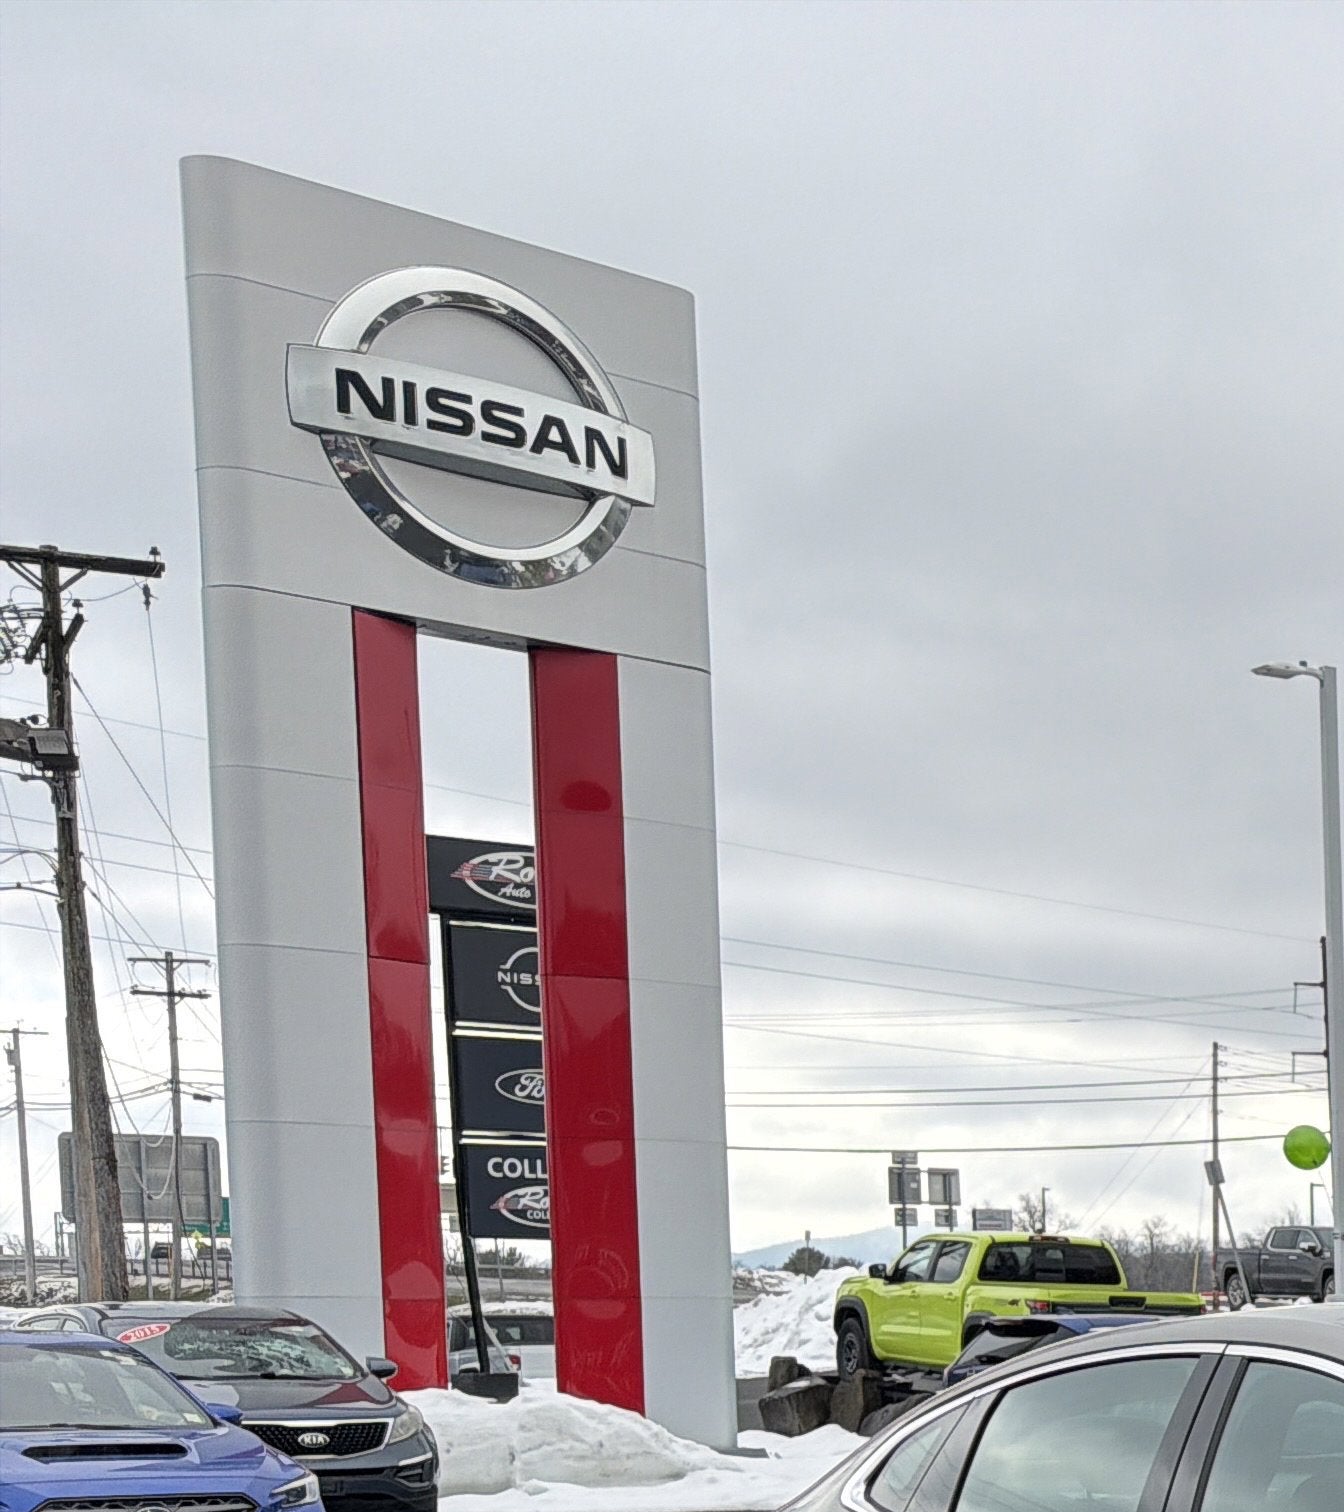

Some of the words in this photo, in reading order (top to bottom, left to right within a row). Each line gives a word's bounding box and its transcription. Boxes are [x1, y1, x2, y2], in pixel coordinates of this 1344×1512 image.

[335, 367, 628, 480] NISSAN
[497, 881, 531, 898] Auto
[304, 1434, 325, 1445] KIA
